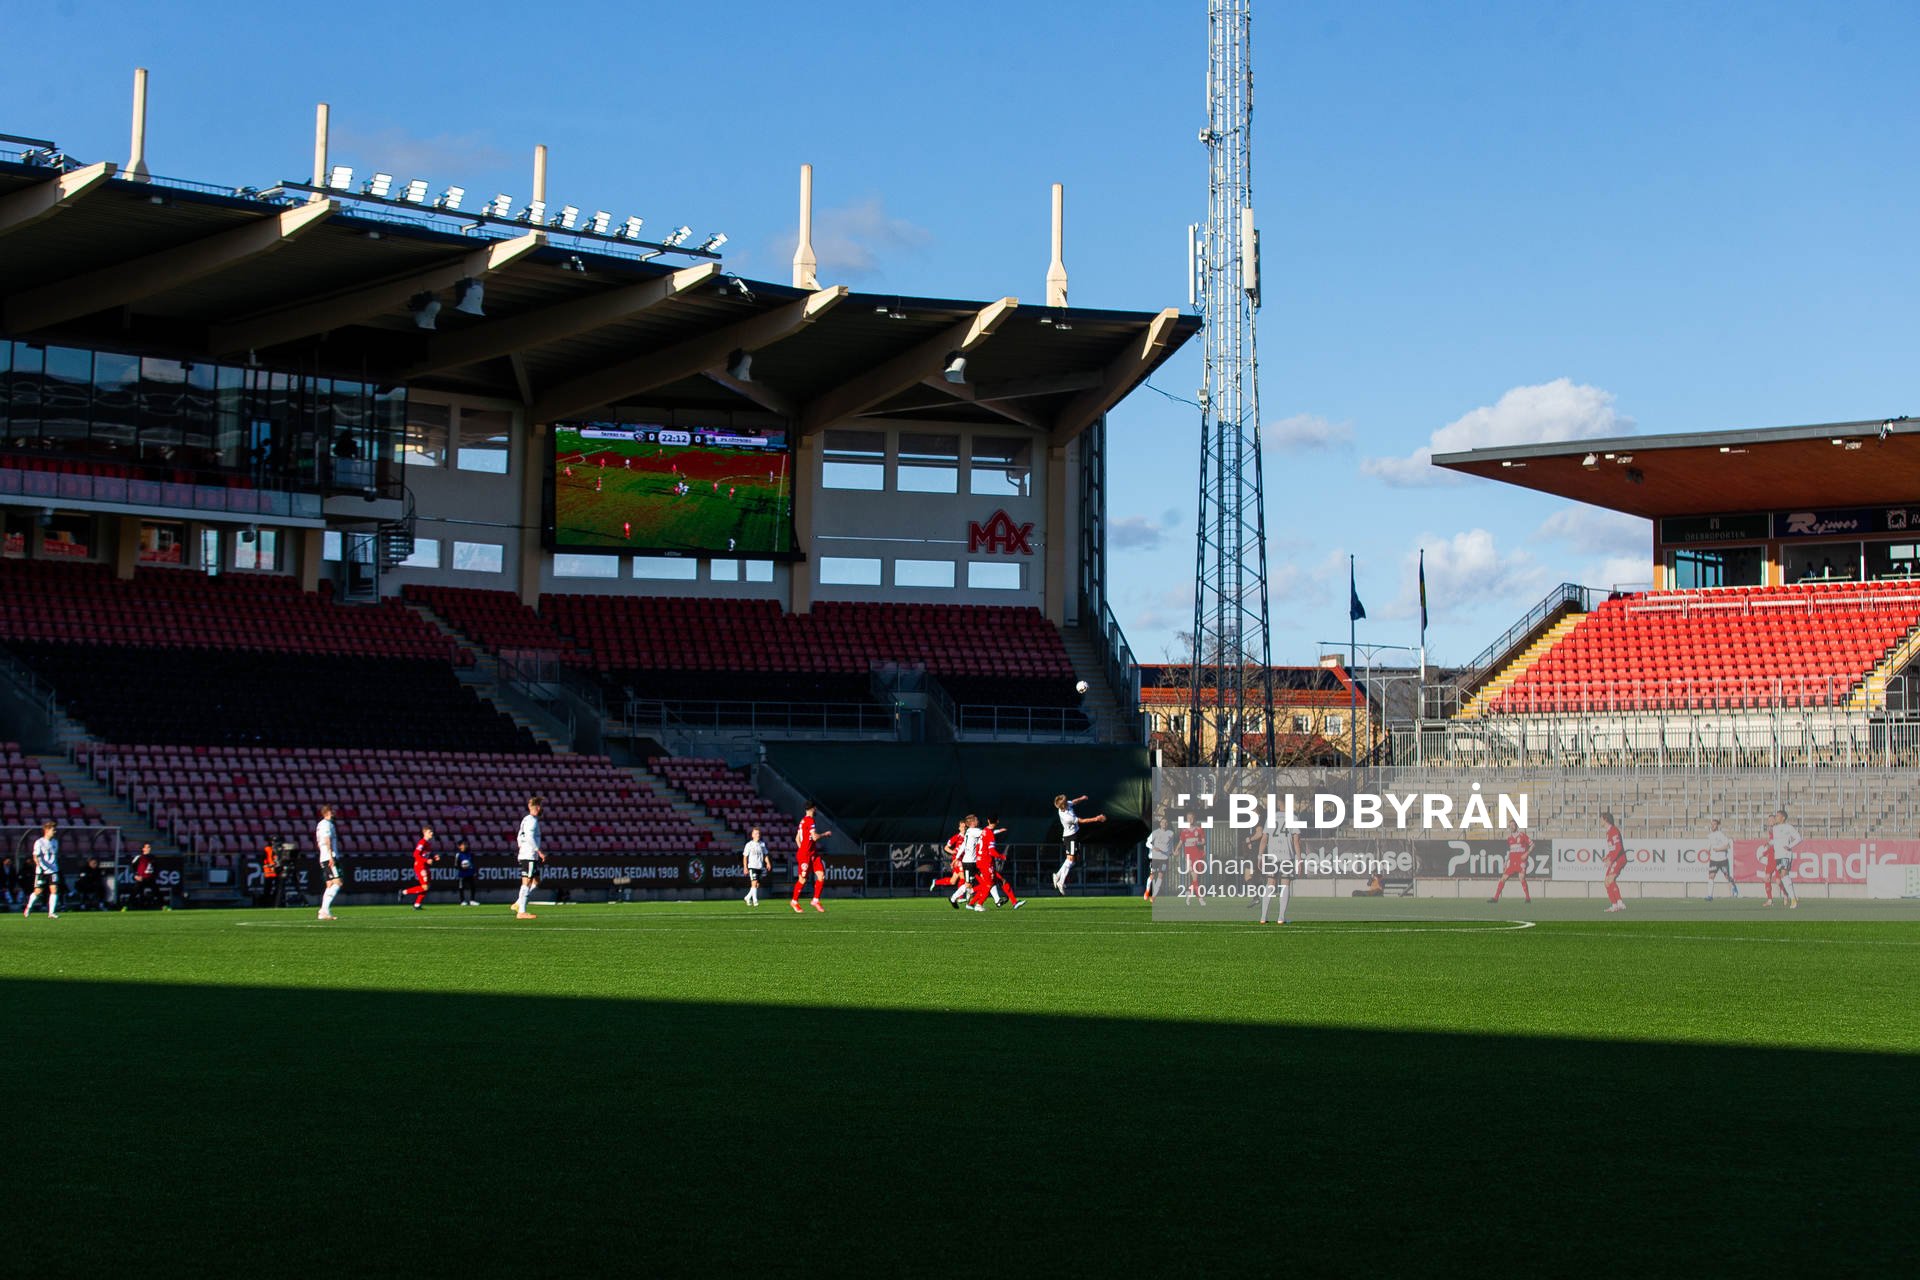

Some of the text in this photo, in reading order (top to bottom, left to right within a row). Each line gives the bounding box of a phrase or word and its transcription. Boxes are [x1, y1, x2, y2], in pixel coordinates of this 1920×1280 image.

[661, 434, 687, 443] 22:12
[968, 508, 1034, 555] MAX
[1557, 848, 1605, 863] ICON
[1625, 848, 1665, 863] CON
[1677, 848, 1710, 863] ICO
[353, 864, 399, 882] ÖREBRO
[571, 866, 578, 879] &
[580, 866, 621, 880] PASSION
[623, 866, 656, 879] SEDAN
[657, 866, 679, 879] 1908
